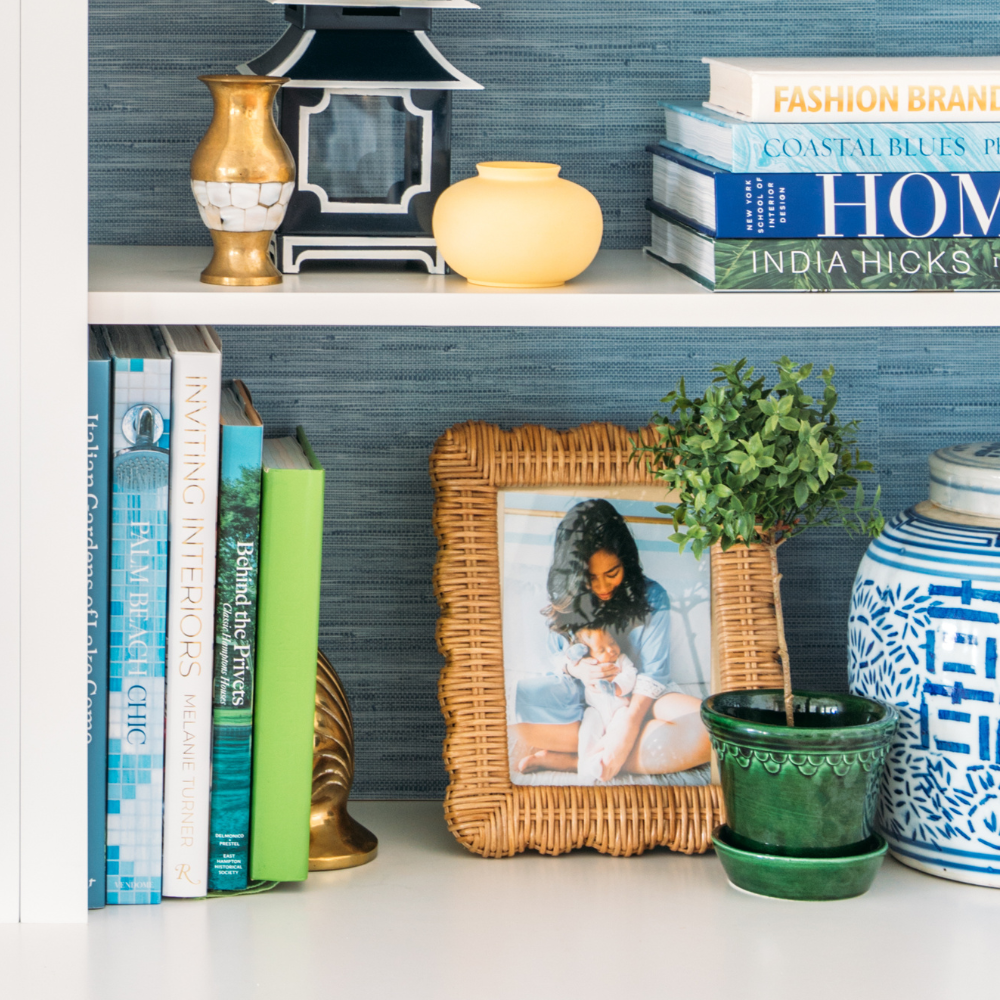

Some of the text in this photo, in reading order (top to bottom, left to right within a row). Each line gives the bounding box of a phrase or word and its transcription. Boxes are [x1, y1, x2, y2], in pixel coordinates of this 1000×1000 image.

[773, 85, 899, 113] FASHION
[763, 137, 885, 158] COASTAL
[889, 137, 966, 158] BLUES
[745, 180, 753, 231] NEW YORK
[756, 176, 765, 234] SCHOOL OF
[767, 182, 775, 228] INTERIOR
[778, 187, 786, 223] DESIGN
[752, 250, 848, 274] INDIA
[861, 250, 971, 275] HICKS
[178, 376, 207, 678] INVITING INTERIORS
[126, 521, 150, 746] PALM BEACH CHIC
[232, 541, 254, 706] Behind the Privets
[219, 602, 233, 706] Classic Hamptons Houses
[180, 694, 197, 848] MELANIE TURNER
[114, 881, 153, 889] VENDOME
